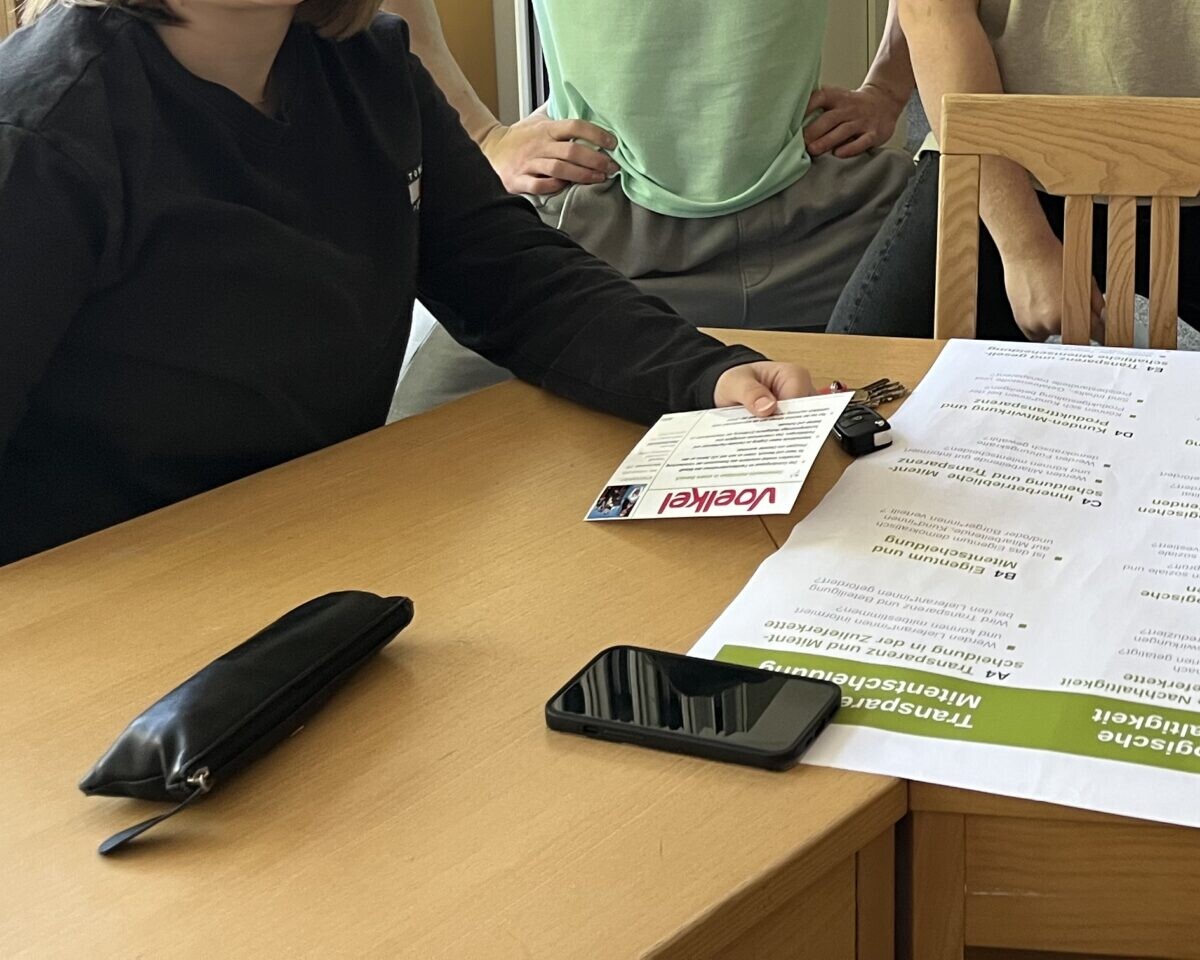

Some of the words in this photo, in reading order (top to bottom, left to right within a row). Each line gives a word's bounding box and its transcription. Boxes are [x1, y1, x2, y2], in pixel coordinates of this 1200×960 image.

[988, 346, 1093, 358] Mitentscheidung
[1060, 355, 1137, 369] Transparenz
[972, 405, 1106, 434] Kunden-Mitwirkung
[974, 399, 1109, 426] Produkttransparenz
[889, 466, 939, 477] Mitent-
[898, 458, 986, 476] Transparenz
[992, 473, 1020, 481] und
[948, 473, 1073, 501] Innerbetriebliche
[1025, 478, 1102, 496] scheidung
[1082, 498, 1101, 507] C4
[872, 546, 903, 556] und
[884, 535, 1017, 569] Mitentscheidung
[909, 553, 985, 574] Eigentum
[995, 570, 1016, 580] B4
[765, 621, 872, 643] Zulieferkette
[764, 635, 823, 648] Mitent-
[826, 642, 861, 653] und
[876, 638, 905, 647] der
[911, 643, 926, 652] in
[866, 648, 972, 675] Transparenz
[931, 645, 1023, 668] scheidung
[986, 670, 1010, 680] A4
[1061, 678, 1191, 704] Nachhaltigkeit
[842, 697, 973, 728] Transpare
